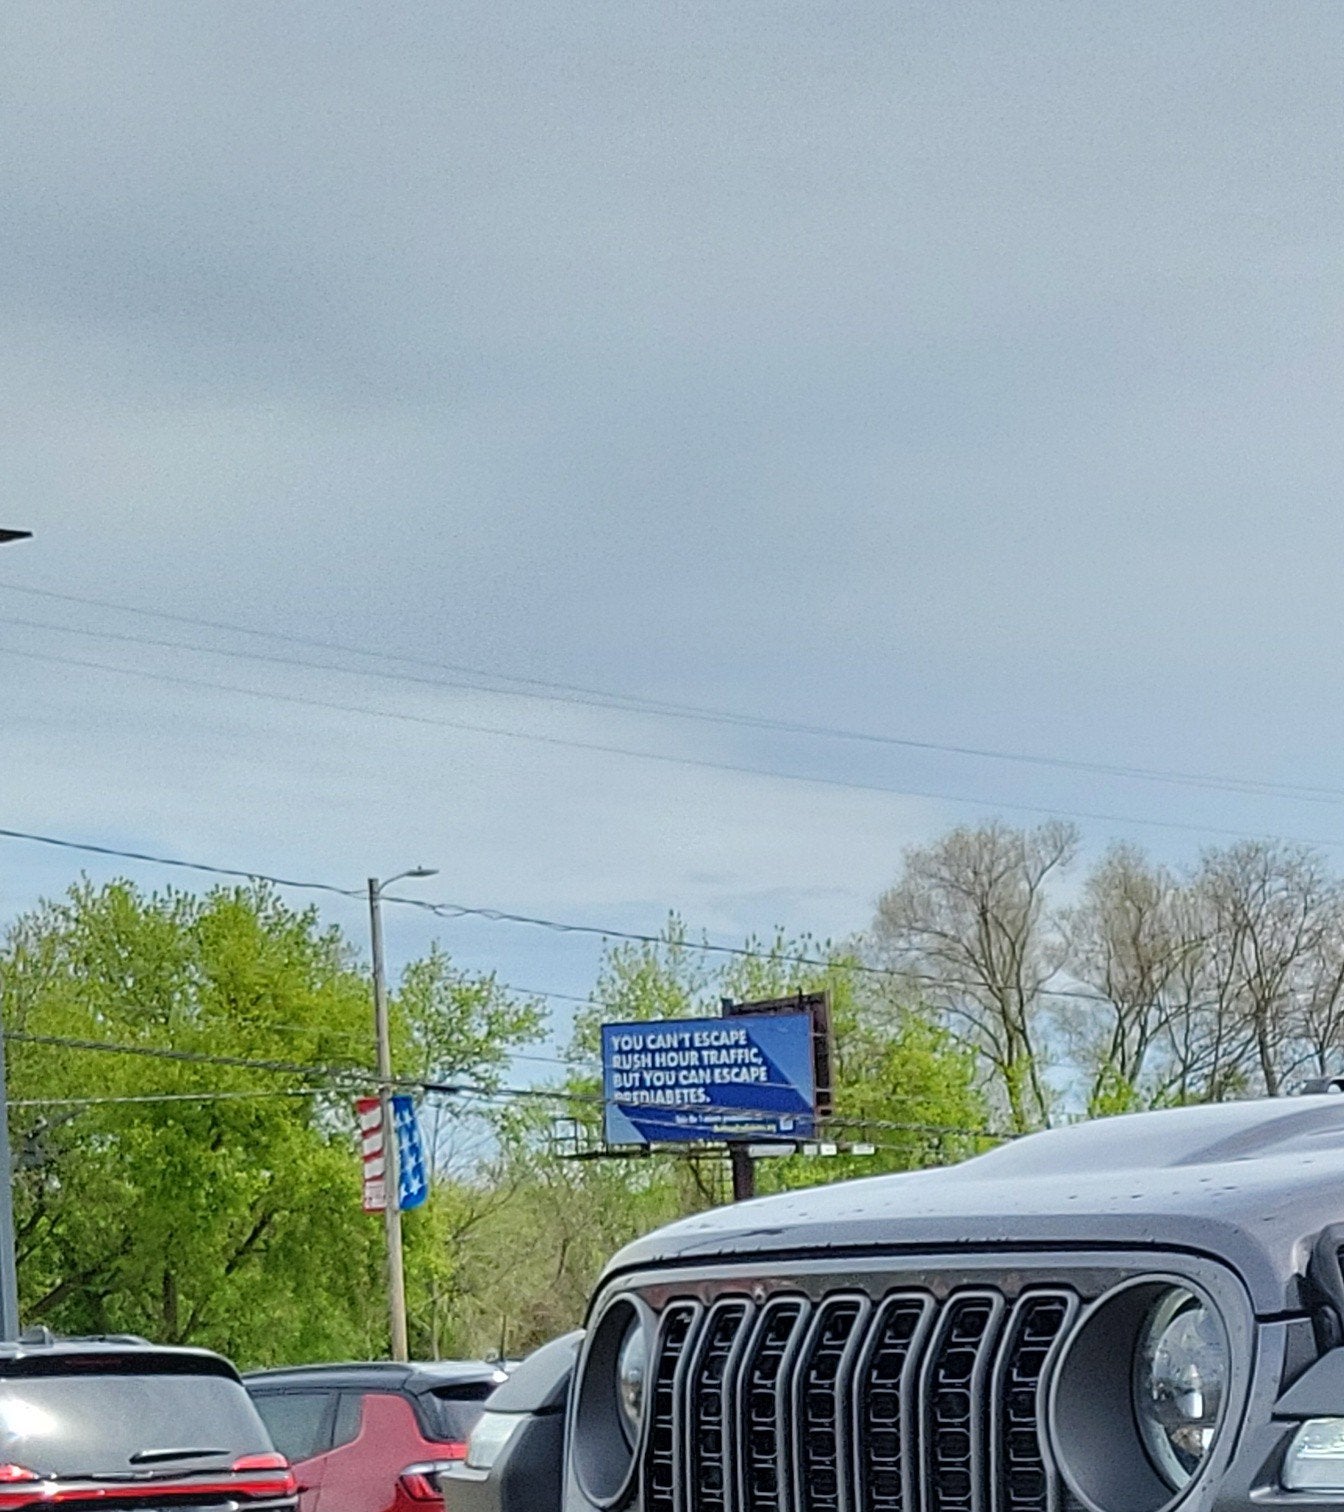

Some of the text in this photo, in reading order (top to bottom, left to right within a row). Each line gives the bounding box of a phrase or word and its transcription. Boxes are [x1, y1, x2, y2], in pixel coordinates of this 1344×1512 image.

[611, 1029, 748, 1051] YOU CAN'T ESCAPE
[612, 1047, 763, 1069] RUSH HOUR TRAFFIC,
[613, 1066, 768, 1088] BUT YOU CAN ESCAPE
